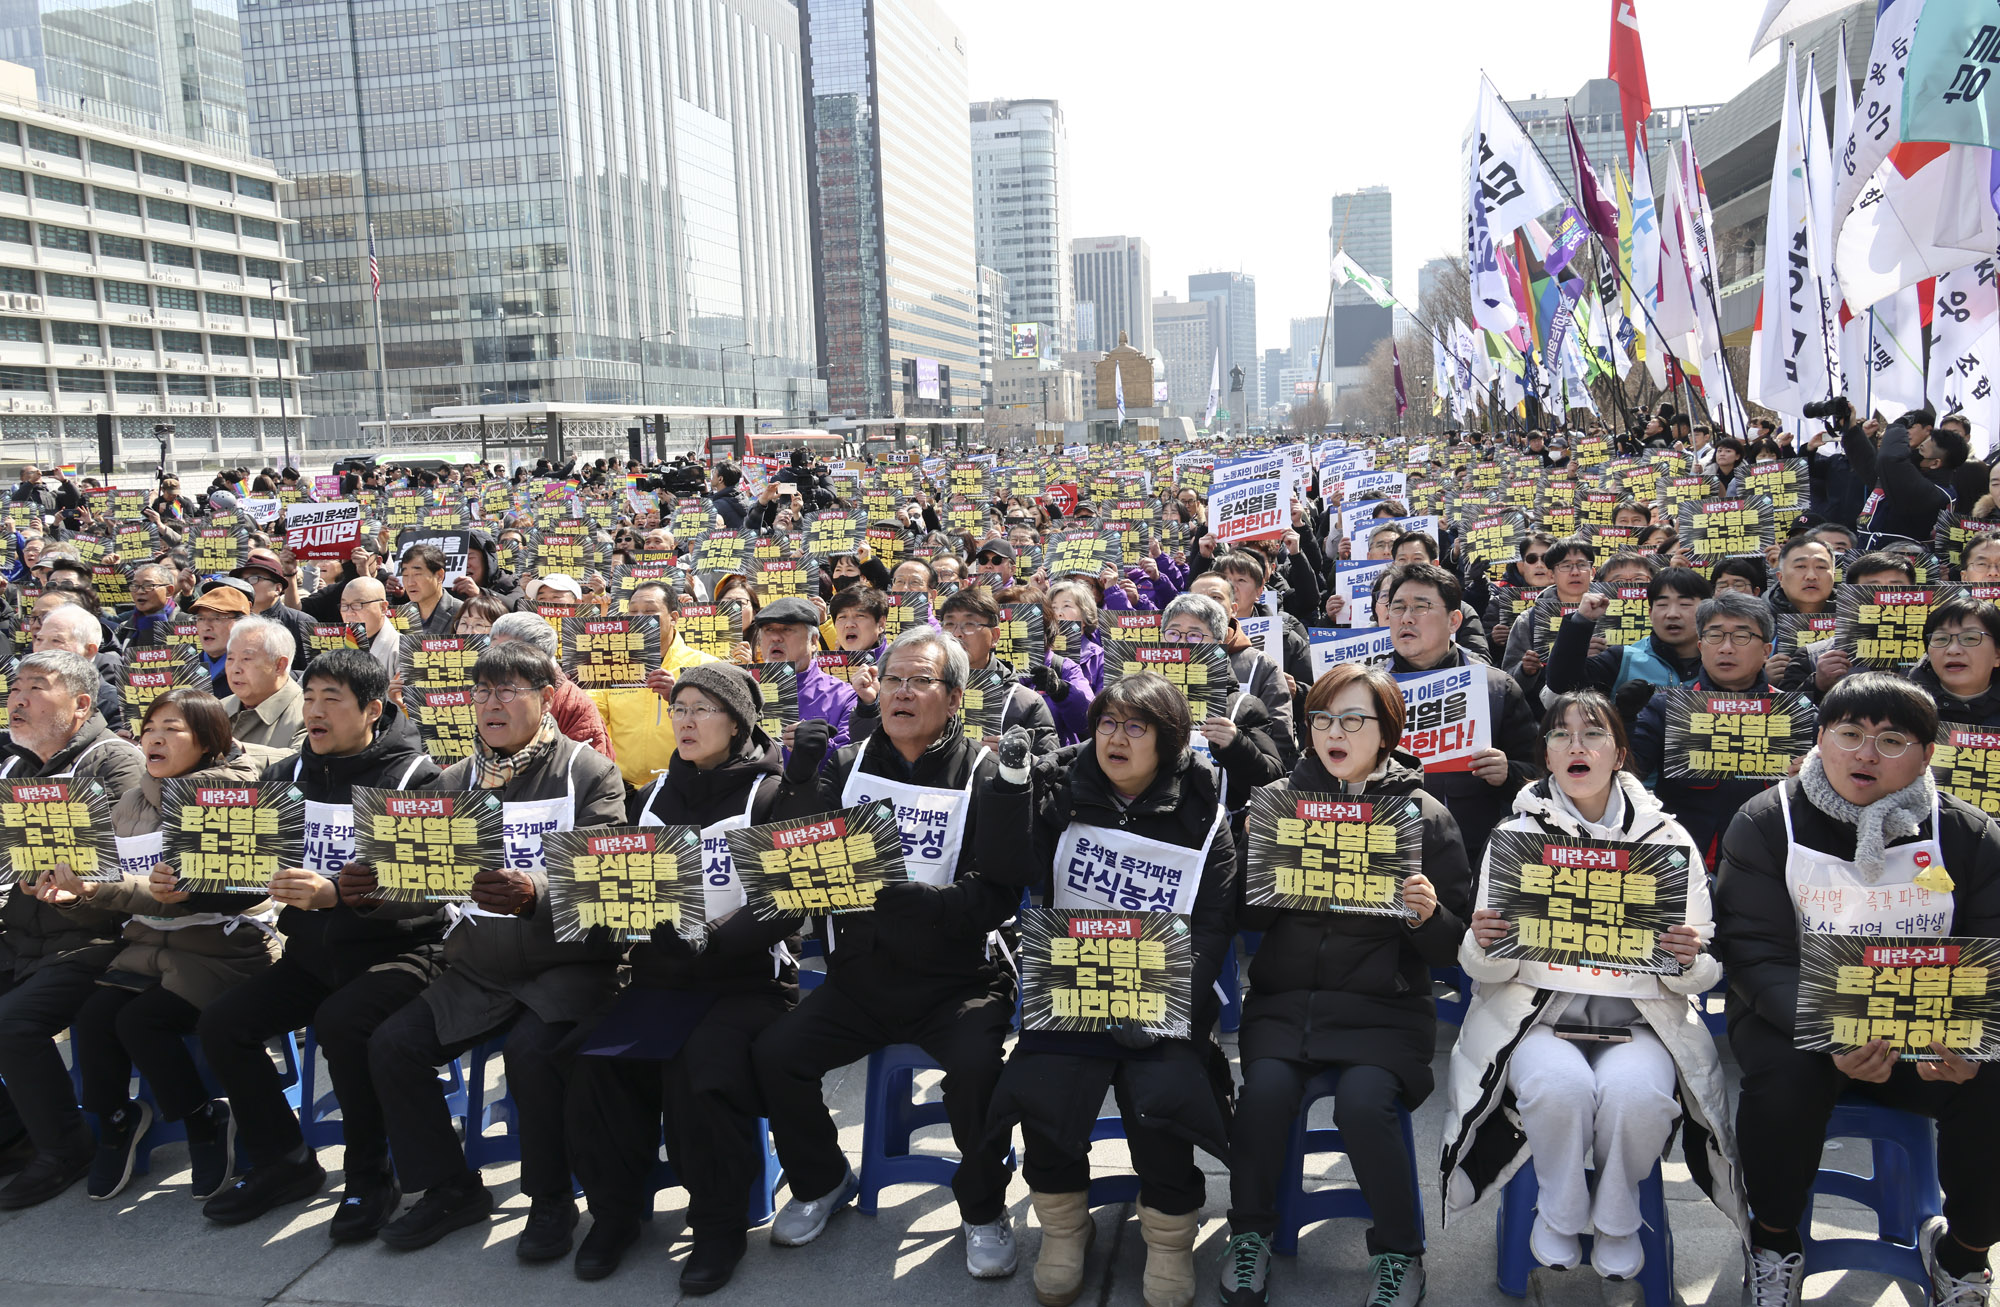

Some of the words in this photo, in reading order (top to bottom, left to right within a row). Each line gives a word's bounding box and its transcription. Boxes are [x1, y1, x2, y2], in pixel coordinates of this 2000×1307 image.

[1223, 466, 1252, 480] 노동자의
[1254, 459, 1284, 472] 이름으로
[1328, 462, 1356, 476] 내란수괴
[1357, 474, 1393, 488] 내란수괴
[1217, 490, 1247, 506] 노동자의
[1249, 482, 1280, 495] 이름으로
[1220, 492, 1278, 520] 윤석열을
[1706, 501, 1739, 511] 내란수괴
[288, 515, 324, 528] 내란수괴
[325, 507, 358, 523] 윤석열
[1217, 509, 1282, 540] 파면한다!
[1693, 509, 1760, 528] 윤석열을
[287, 522, 358, 550] 즉시파면
[1693, 535, 1760, 554] 파면하라
[1622, 588, 1648, 599] 내란수
[1880, 592, 1925, 603] 내란수괴
[684, 606, 712, 616] 내란수괴
[1121, 616, 1156, 627] 내란수괴
[1857, 604, 1932, 625] 윤석열
[178, 626, 198, 634] 내란수
[317, 627, 340, 635] 내란수괴
[589, 621, 623, 632] 내란수괴
[310, 636, 347, 649] 윤석열
[425, 641, 458, 650] 내란수괴
[576, 633, 645, 651] 윤석열을
[1856, 639, 1926, 660] 파면하
[413, 651, 479, 668] 윤석열을
[818, 655, 843, 666] 란수괴
[1141, 649, 1183, 661] 내란수괴
[1325, 644, 1366, 664] 노동자의
[132, 674, 166, 685] 내란수괴
[577, 664, 646, 682] 파면하라
[1417, 670, 1471, 700] 이름으로
[429, 693, 464, 704] 내란수괴
[1713, 700, 1762, 712] 내란수괴
[420, 704, 476, 725] 윤석열
[1689, 714, 1792, 737] 윤석열을
[1688, 750, 1791, 773] 파면하라
[18, 786, 61, 801] 내란수괴
[202, 790, 249, 804] 내란수괴
[2, 802, 91, 828] 윤석열을
[392, 800, 444, 814] 내란수괴
[1304, 803, 1362, 819] 내란수괴
[181, 806, 279, 834] 윤석열을
[373, 815, 478, 844] 윤석열을
[595, 835, 647, 852] 내란수괴
[779, 821, 836, 845] 내란수괴
[1276, 818, 1397, 854] 윤석열을
[759, 833, 877, 874] 윤석열을
[1076, 838, 1118, 868] 윤석열
[1121, 856, 1182, 886] 즉각파면
[1551, 848, 1616, 867] 내란수괴
[181, 852, 279, 881] 파면하라
[377, 861, 479, 891] 파면하라
[573, 853, 679, 882] 윤석열을
[1068, 858, 1177, 912] 단식농성
[1274, 867, 1395, 903] 파면하라
[1520, 864, 1658, 906] 윤석열을
[1798, 884, 1844, 914] 윤석열
[1866, 891, 1892, 912] 즉각
[1899, 888, 1932, 907] 파면
[1076, 920, 1132, 935] 내란수괴
[1896, 912, 1945, 934] 대학생
[1518, 916, 1654, 960] 파면하라
[1051, 938, 1166, 970] 윤석열을
[1873, 947, 1945, 964] 내란수괴
[1835, 965, 1989, 996] 윤석열을
[1051, 989, 1166, 1021] 파면하라
[1832, 1016, 1983, 1048] 파면하라
